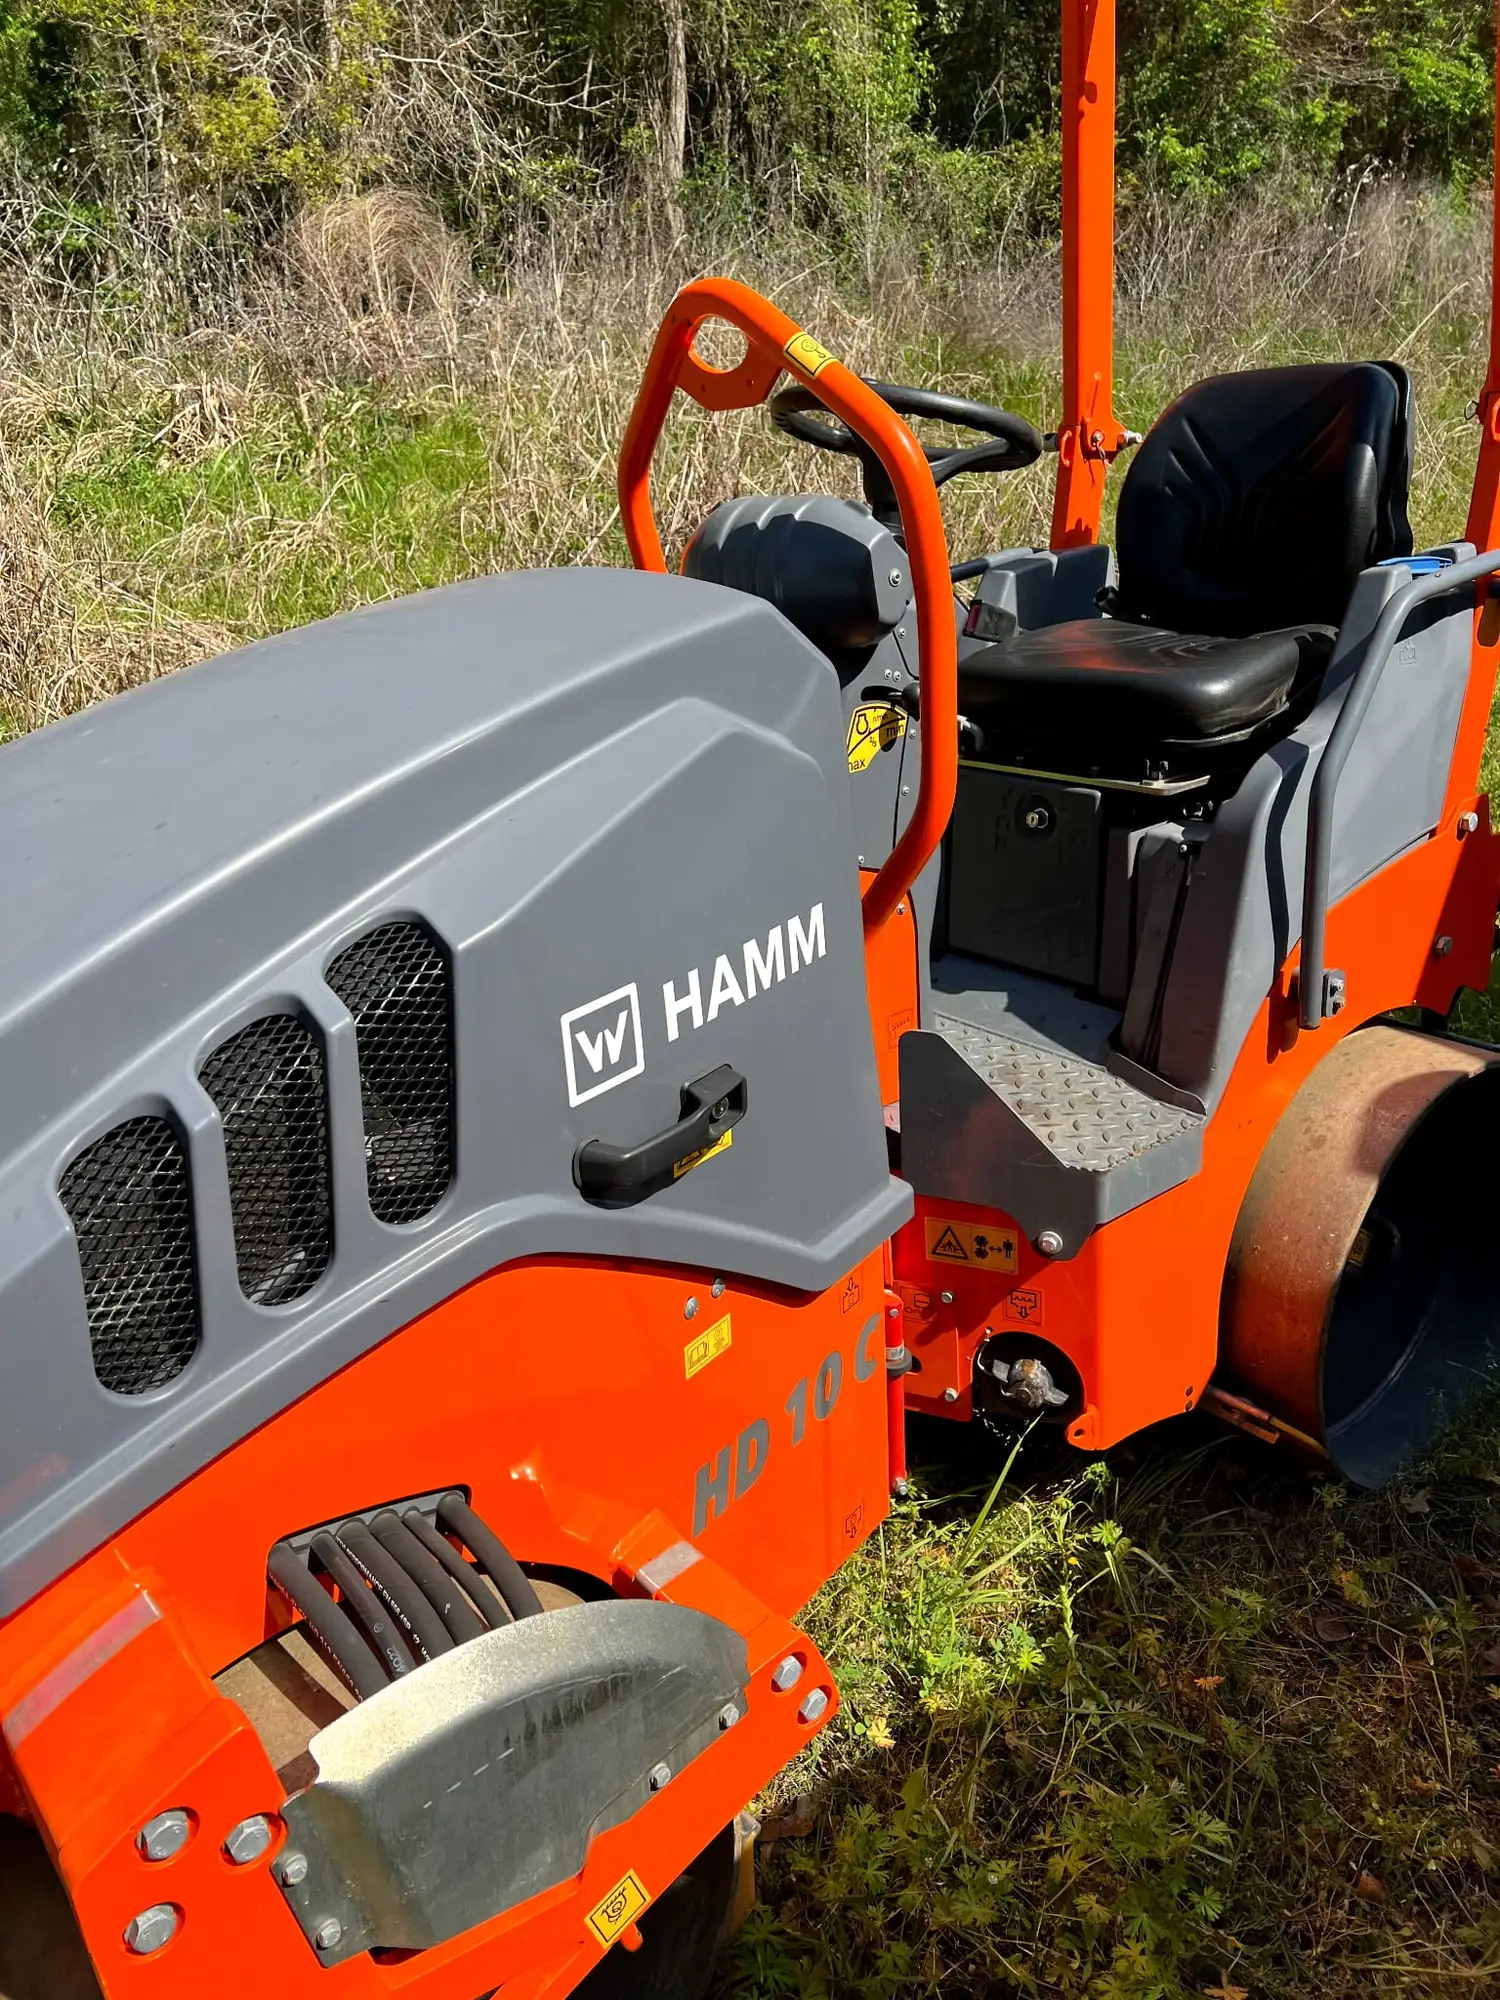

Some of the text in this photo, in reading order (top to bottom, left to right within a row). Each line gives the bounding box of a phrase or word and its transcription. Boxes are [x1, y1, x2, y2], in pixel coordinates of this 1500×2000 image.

[886, 723, 905, 738] min
[662, 901, 827, 1043] HAMM
[692, 1312, 882, 1540] HD 10 C
